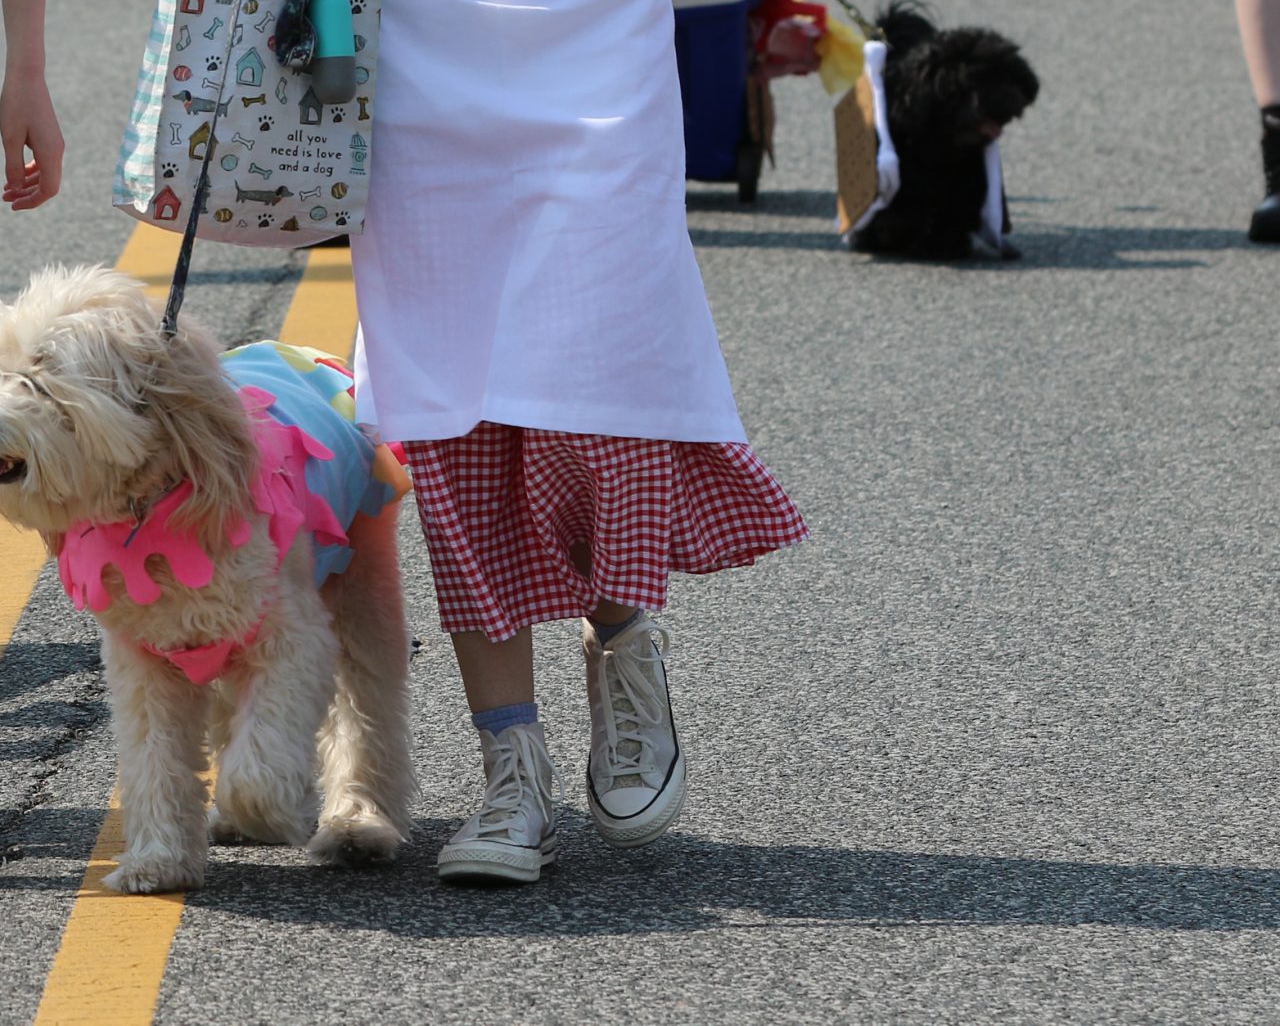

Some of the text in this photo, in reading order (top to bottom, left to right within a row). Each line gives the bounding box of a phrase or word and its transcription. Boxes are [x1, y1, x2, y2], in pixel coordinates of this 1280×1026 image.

[287, 129, 328, 146] all you
[271, 145, 342, 160] need is love
[279, 160, 299, 172] and
[313, 162, 334, 177] dog
